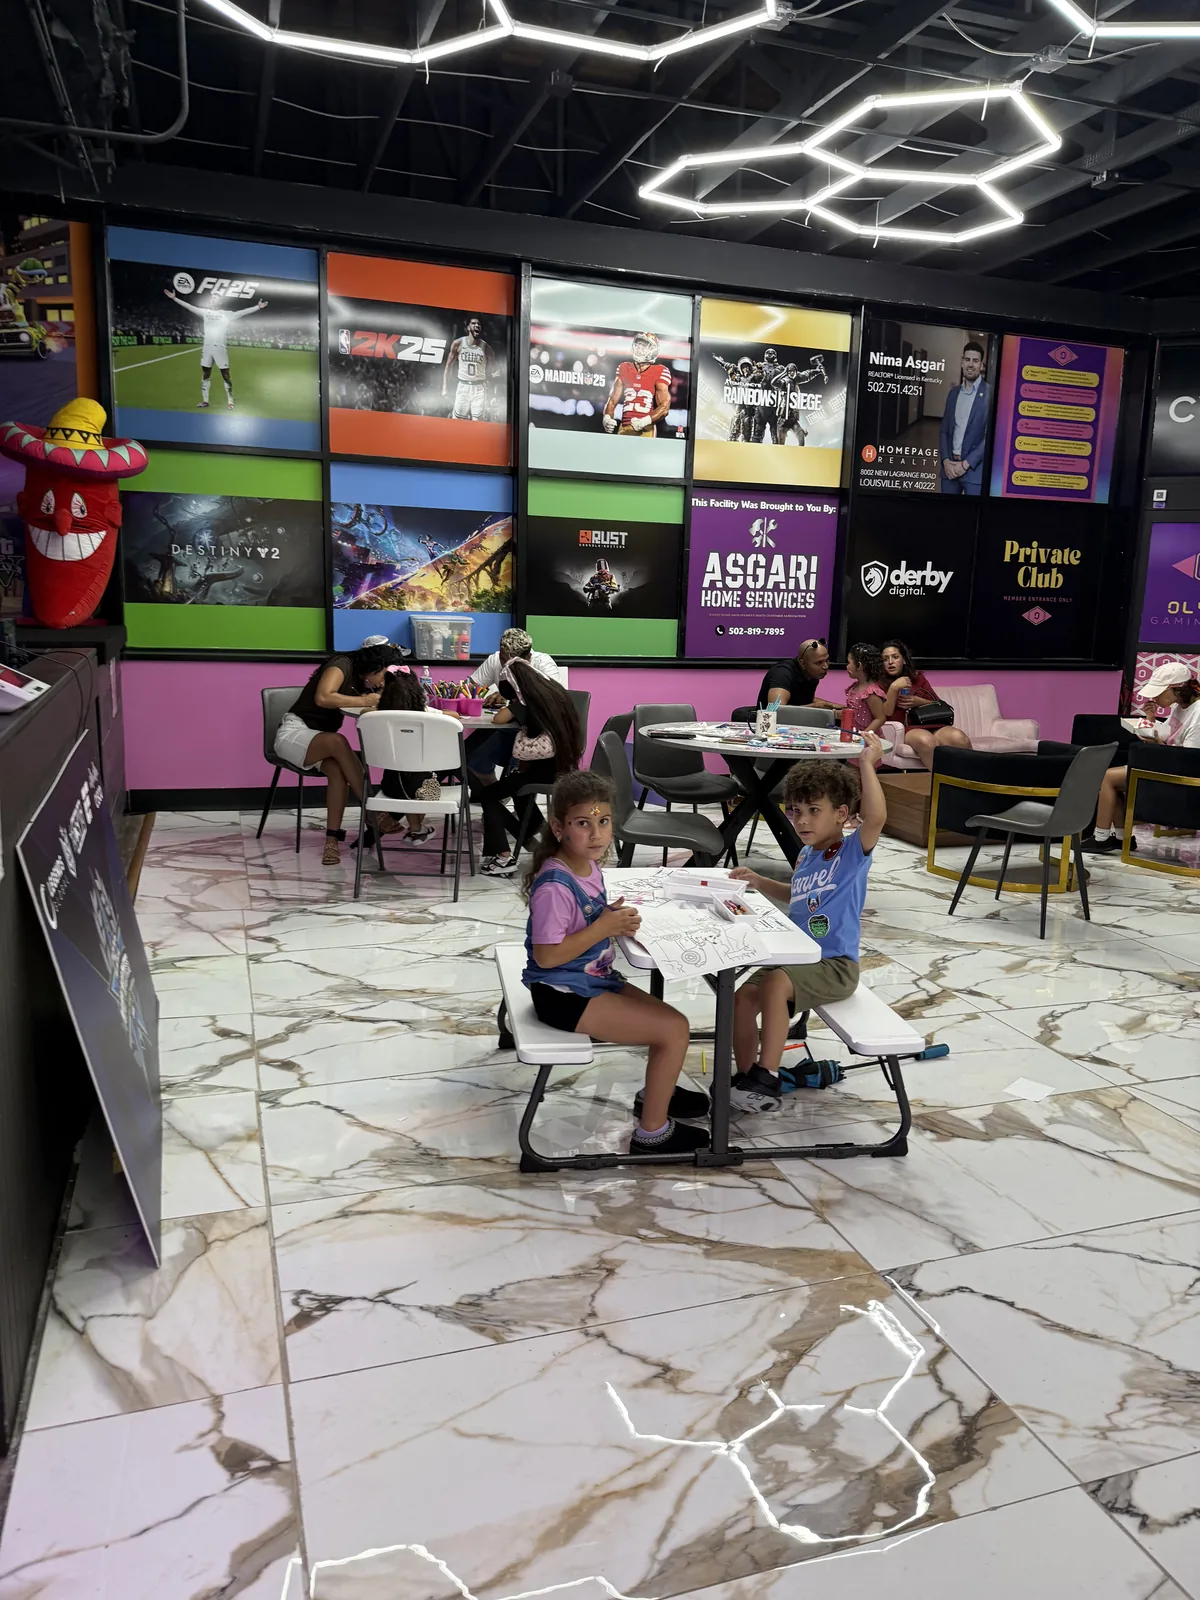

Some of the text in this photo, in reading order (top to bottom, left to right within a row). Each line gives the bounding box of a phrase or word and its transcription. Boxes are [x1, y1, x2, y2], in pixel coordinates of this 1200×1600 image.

[350, 330, 447, 364] 2K25
[467, 363, 476, 376] 0
[869, 351, 945, 373] Nima Asgari
[544, 368, 584, 385] MADDEN
[592, 374, 606, 387] 25
[894, 373, 915, 382] Licensed
[921, 376, 943, 385] Kentucky
[867, 381, 923, 396] 502.751.4251
[622, 387, 654, 413] 23
[789, 391, 823, 411] SIEGE
[878, 445, 939, 457] HOMEPAGE
[877, 457, 938, 466] REALTY
[875, 469, 889, 477] NEW
[889, 470, 920, 479] LAGRANGE
[859, 478, 936, 490] LOUISVILLE, KY 40222
[691, 498, 837, 515] This Facility Was Brought to You By:
[591, 530, 628, 545] RUST
[171, 544, 280, 560] DESTINY 2
[1003, 540, 1082, 565] Private
[702, 552, 818, 590] ASGARI
[889, 560, 954, 593] derby
[1017, 565, 1064, 589] Club
[701, 589, 816, 609] HOME SERVICES
[889, 586, 926, 597] digital.
[1167, 601, 1200, 615] OL
[728, 627, 785, 636] 502-819-7895
[791, 855, 841, 896] arvel
